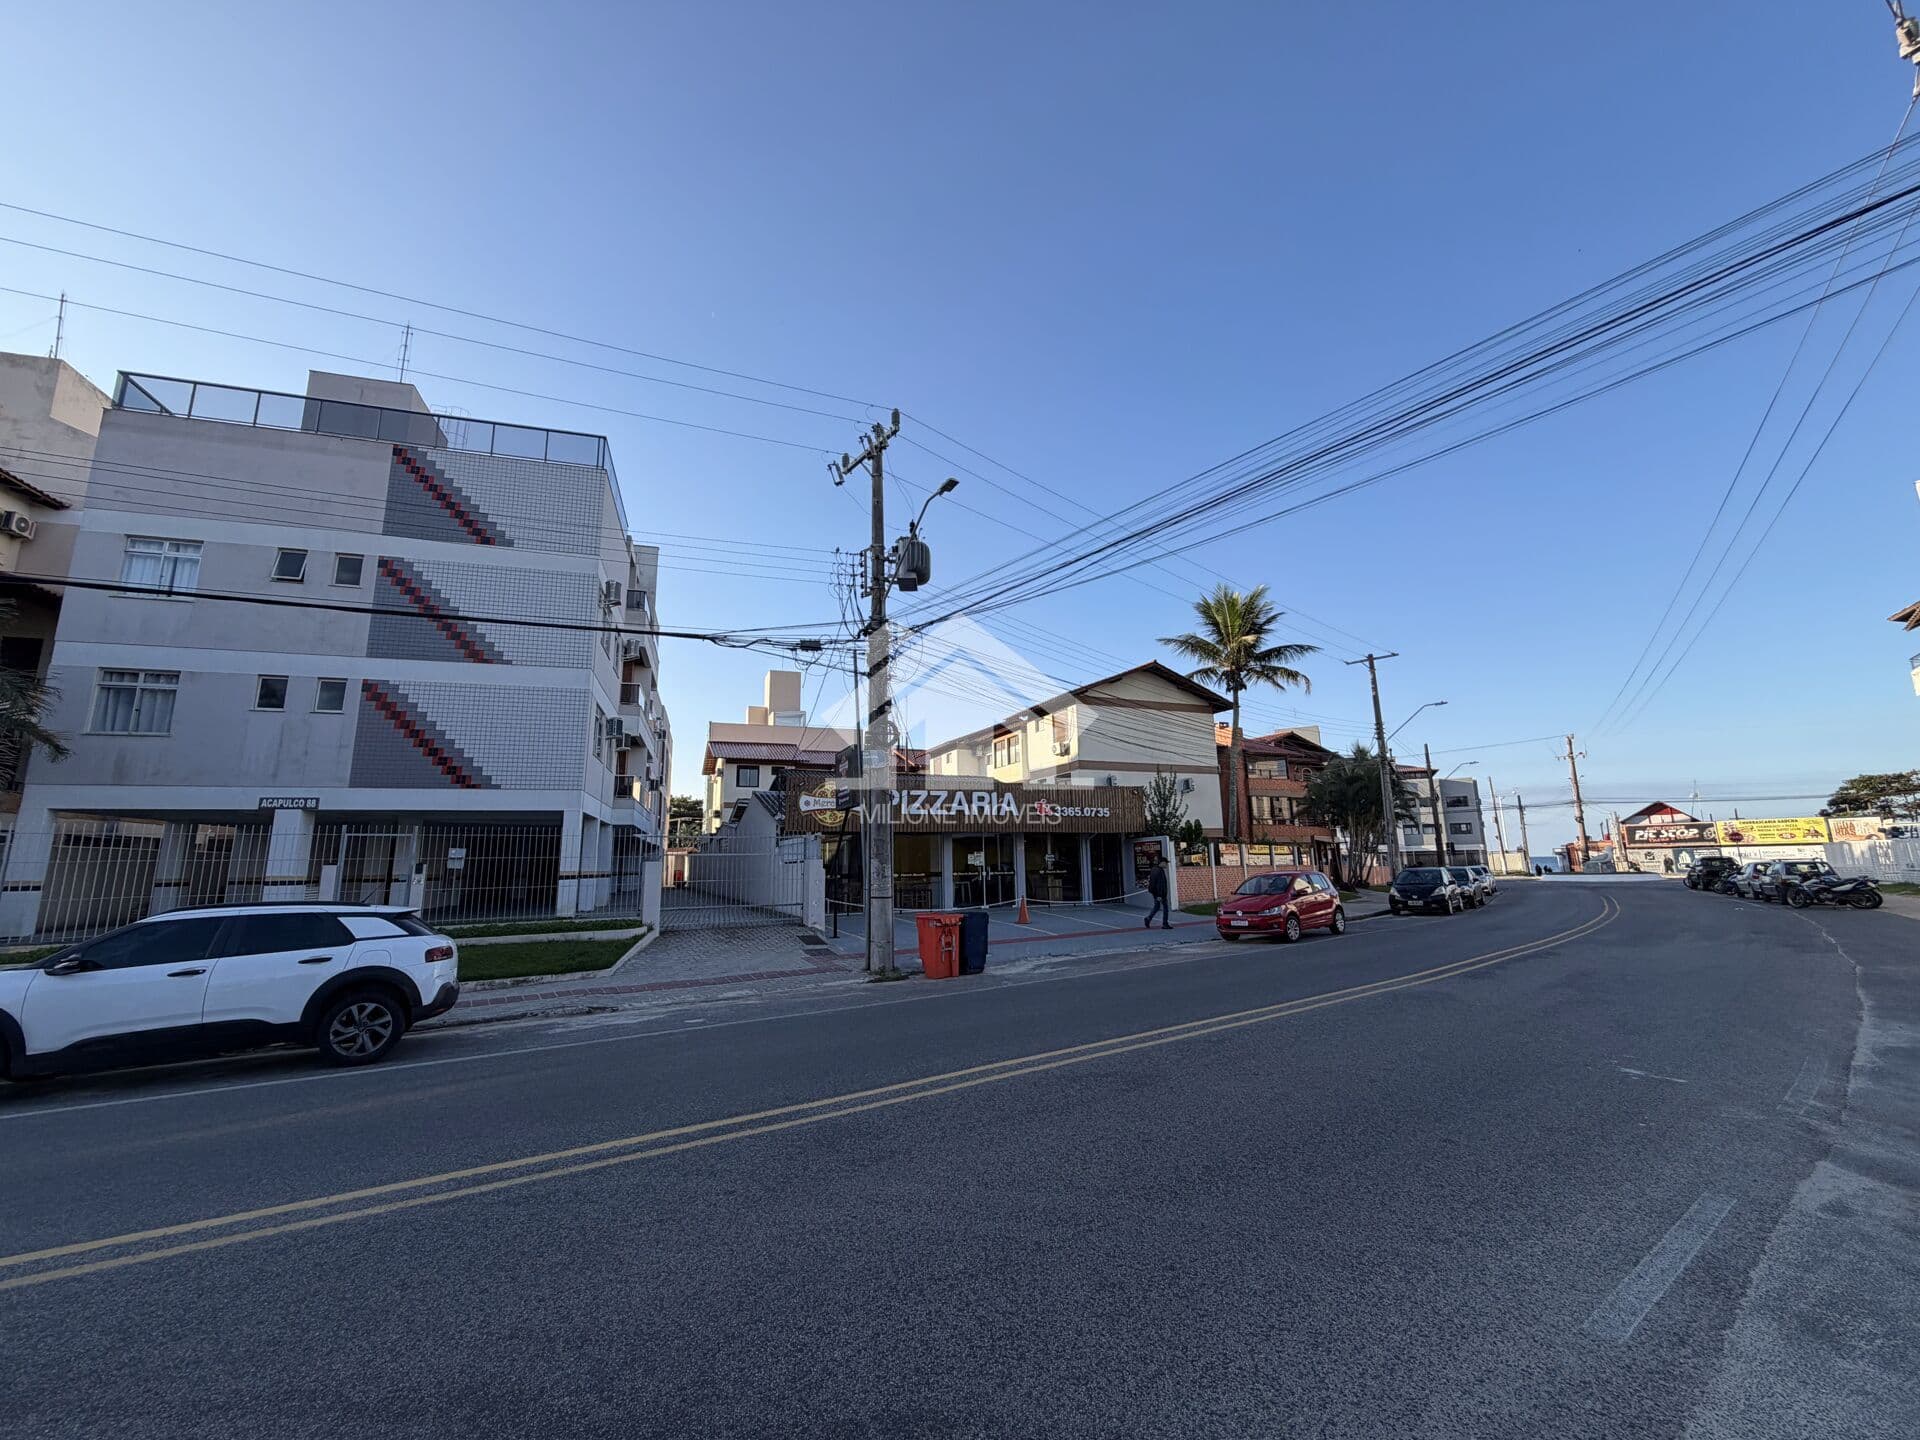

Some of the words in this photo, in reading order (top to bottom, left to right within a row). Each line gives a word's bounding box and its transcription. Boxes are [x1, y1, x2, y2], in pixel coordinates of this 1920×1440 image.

[261, 798, 305, 807] ACAPULCO
[888, 789, 1019, 816] PIZZARIA
[1055, 806, 1110, 817] 3365.0735
